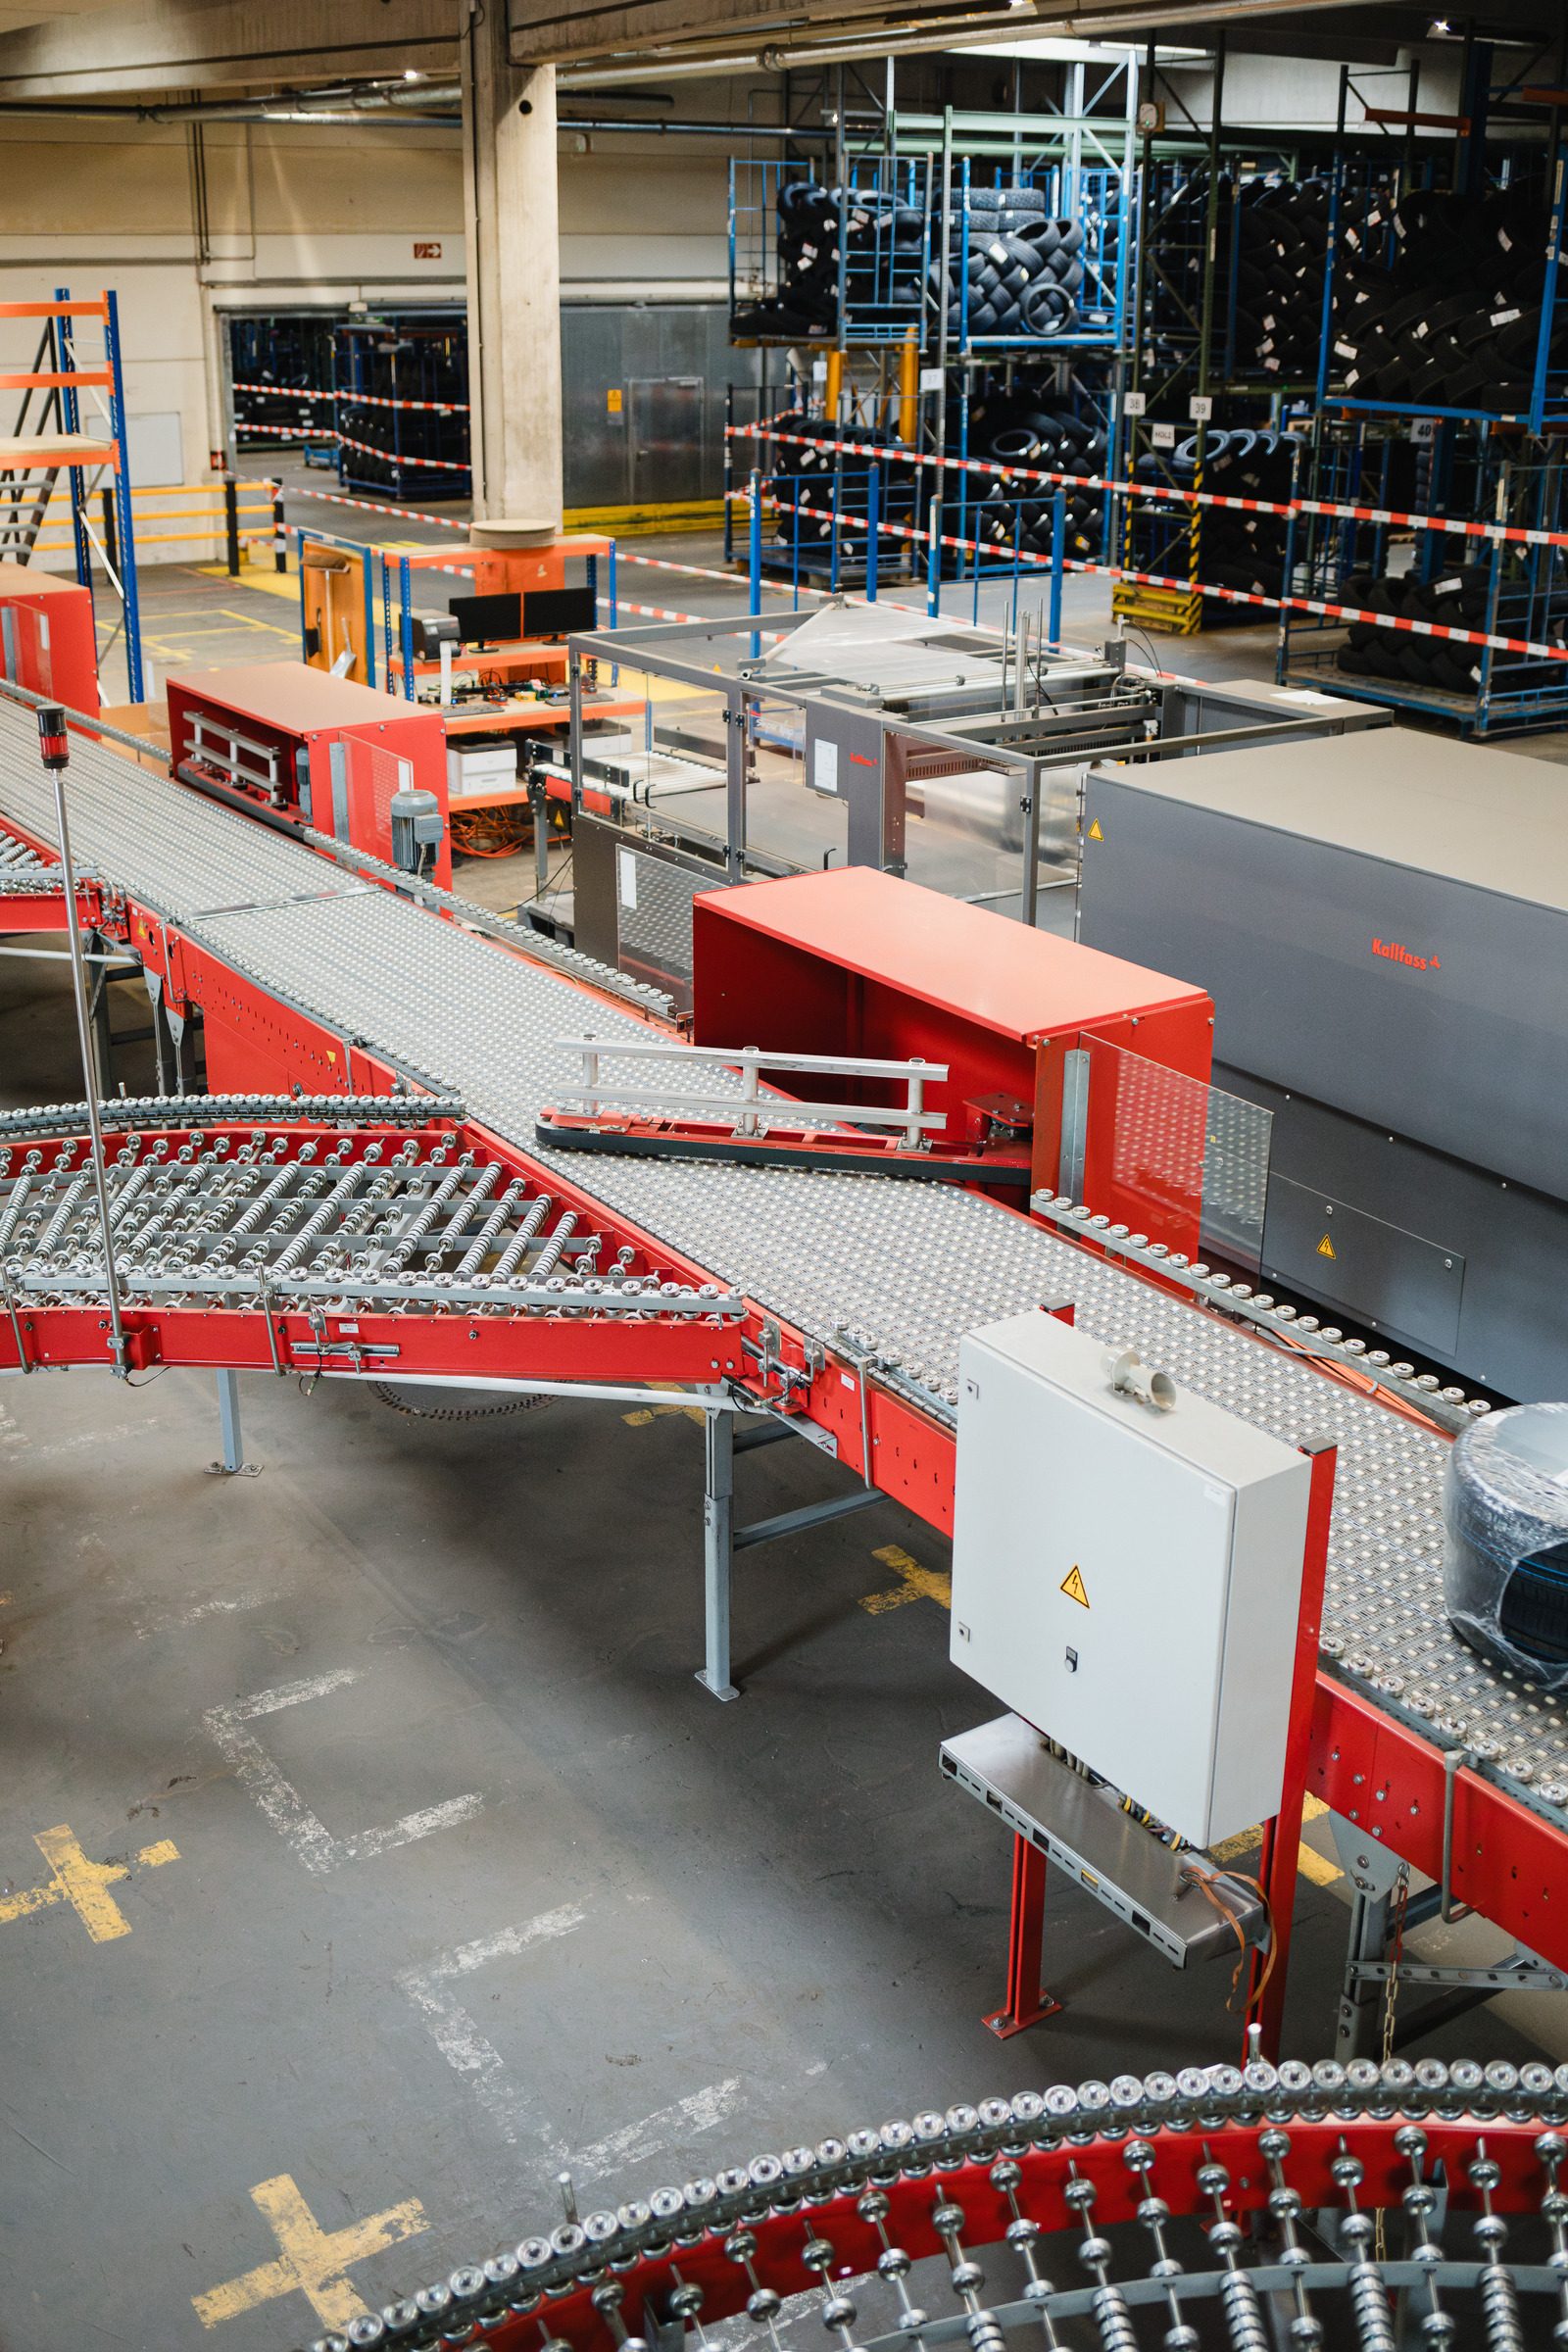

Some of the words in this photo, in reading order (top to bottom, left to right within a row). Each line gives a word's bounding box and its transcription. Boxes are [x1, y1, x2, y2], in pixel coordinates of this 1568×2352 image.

[1196, 403, 1206, 414] 39
[1417, 423, 1431, 437] 40
[1372, 937, 1427, 971] Kallfass
